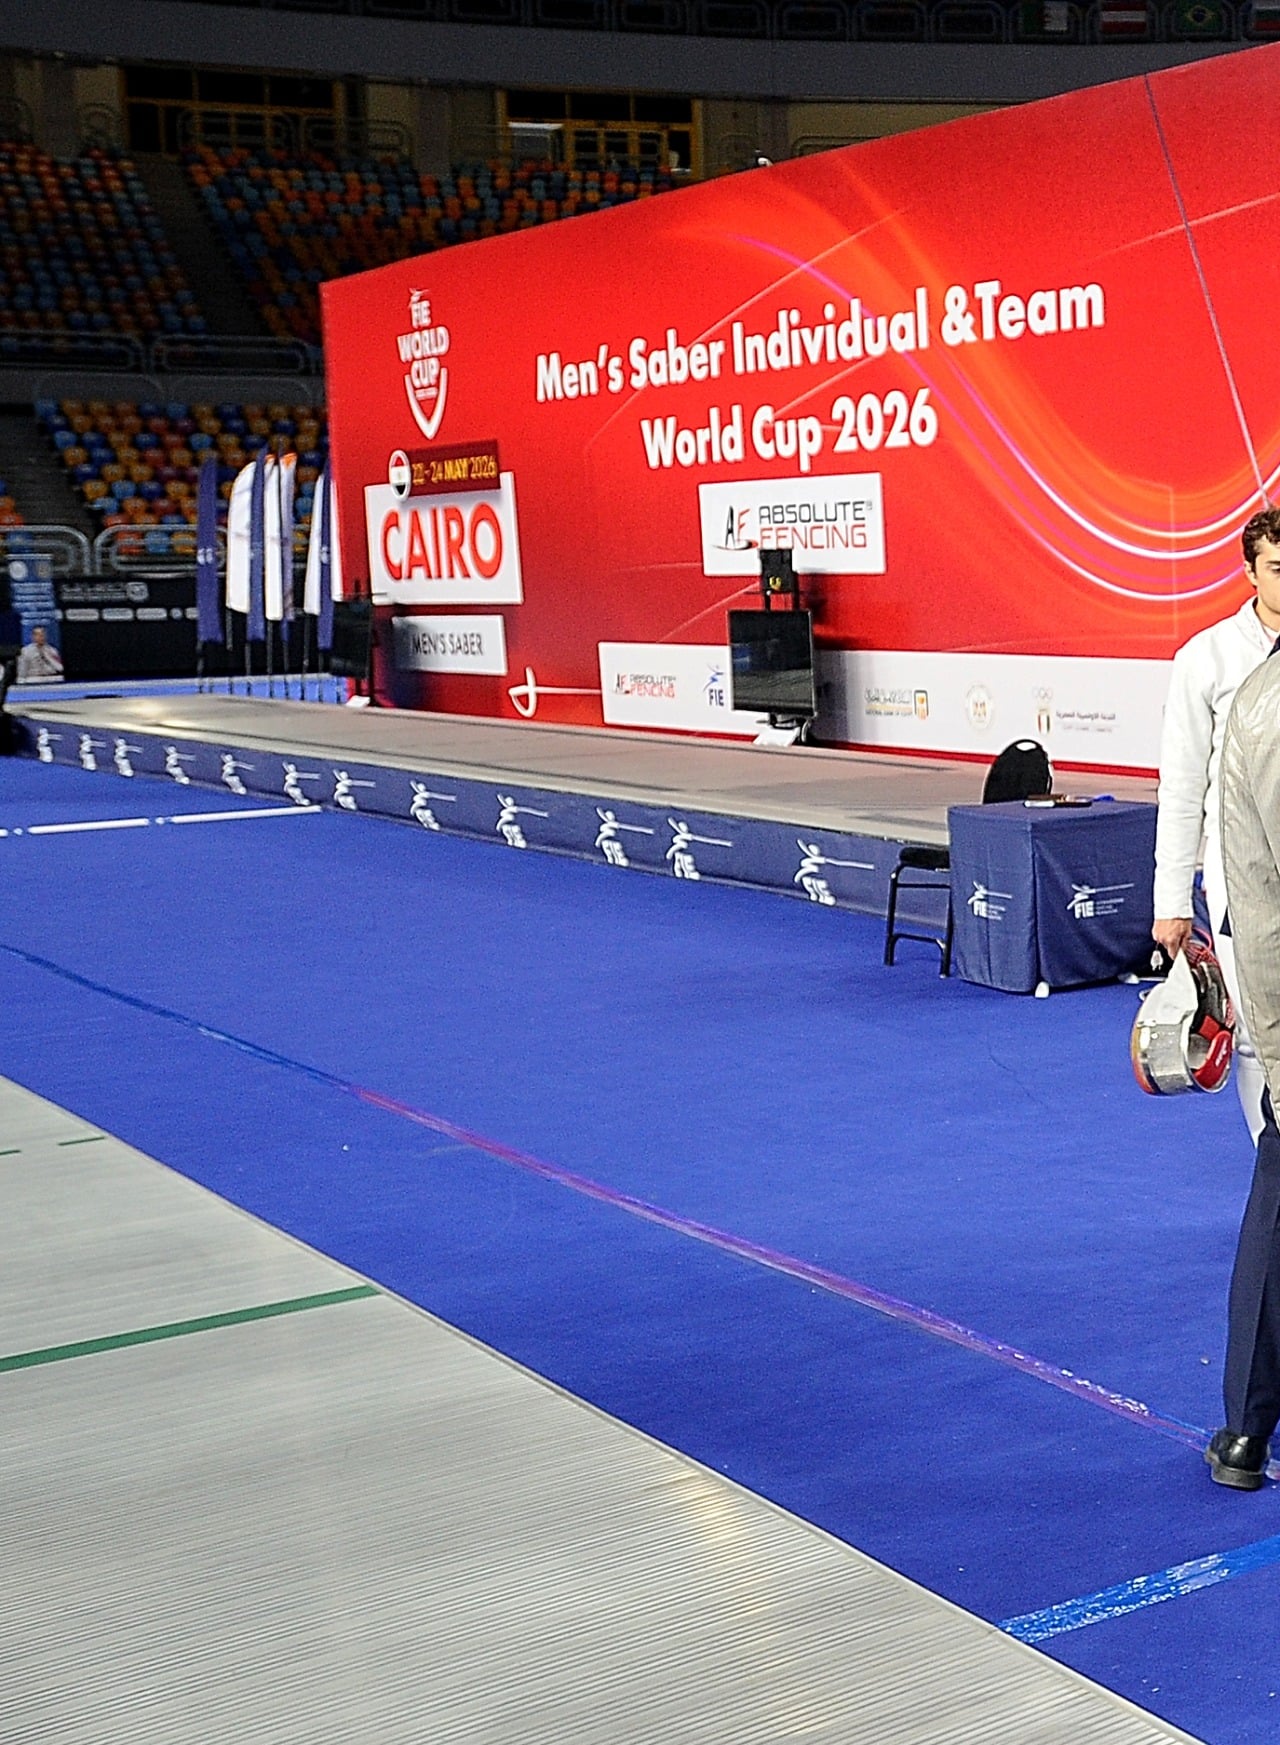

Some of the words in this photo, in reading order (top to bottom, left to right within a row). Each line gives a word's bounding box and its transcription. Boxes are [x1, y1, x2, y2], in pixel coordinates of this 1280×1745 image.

[397, 326, 449, 363] WORLD
[536, 344, 624, 402] Men's
[629, 328, 725, 390] Saber
[732, 286, 930, 375] Individual
[941, 280, 1105, 346] &Team
[411, 357, 440, 388] CUP
[640, 404, 744, 469] World
[752, 405, 823, 473] Cup
[831, 388, 938, 453] 2026
[444, 458, 468, 480] MAY
[759, 501, 866, 525] ABSOLUTE
[381, 502, 503, 581] CAIRO
[759, 524, 868, 550] FENCING
[412, 632, 446, 655] MEN'S
[448, 632, 484, 656] SABER
[709, 688, 725, 706] FIE
[1074, 900, 1095, 919] FIE
